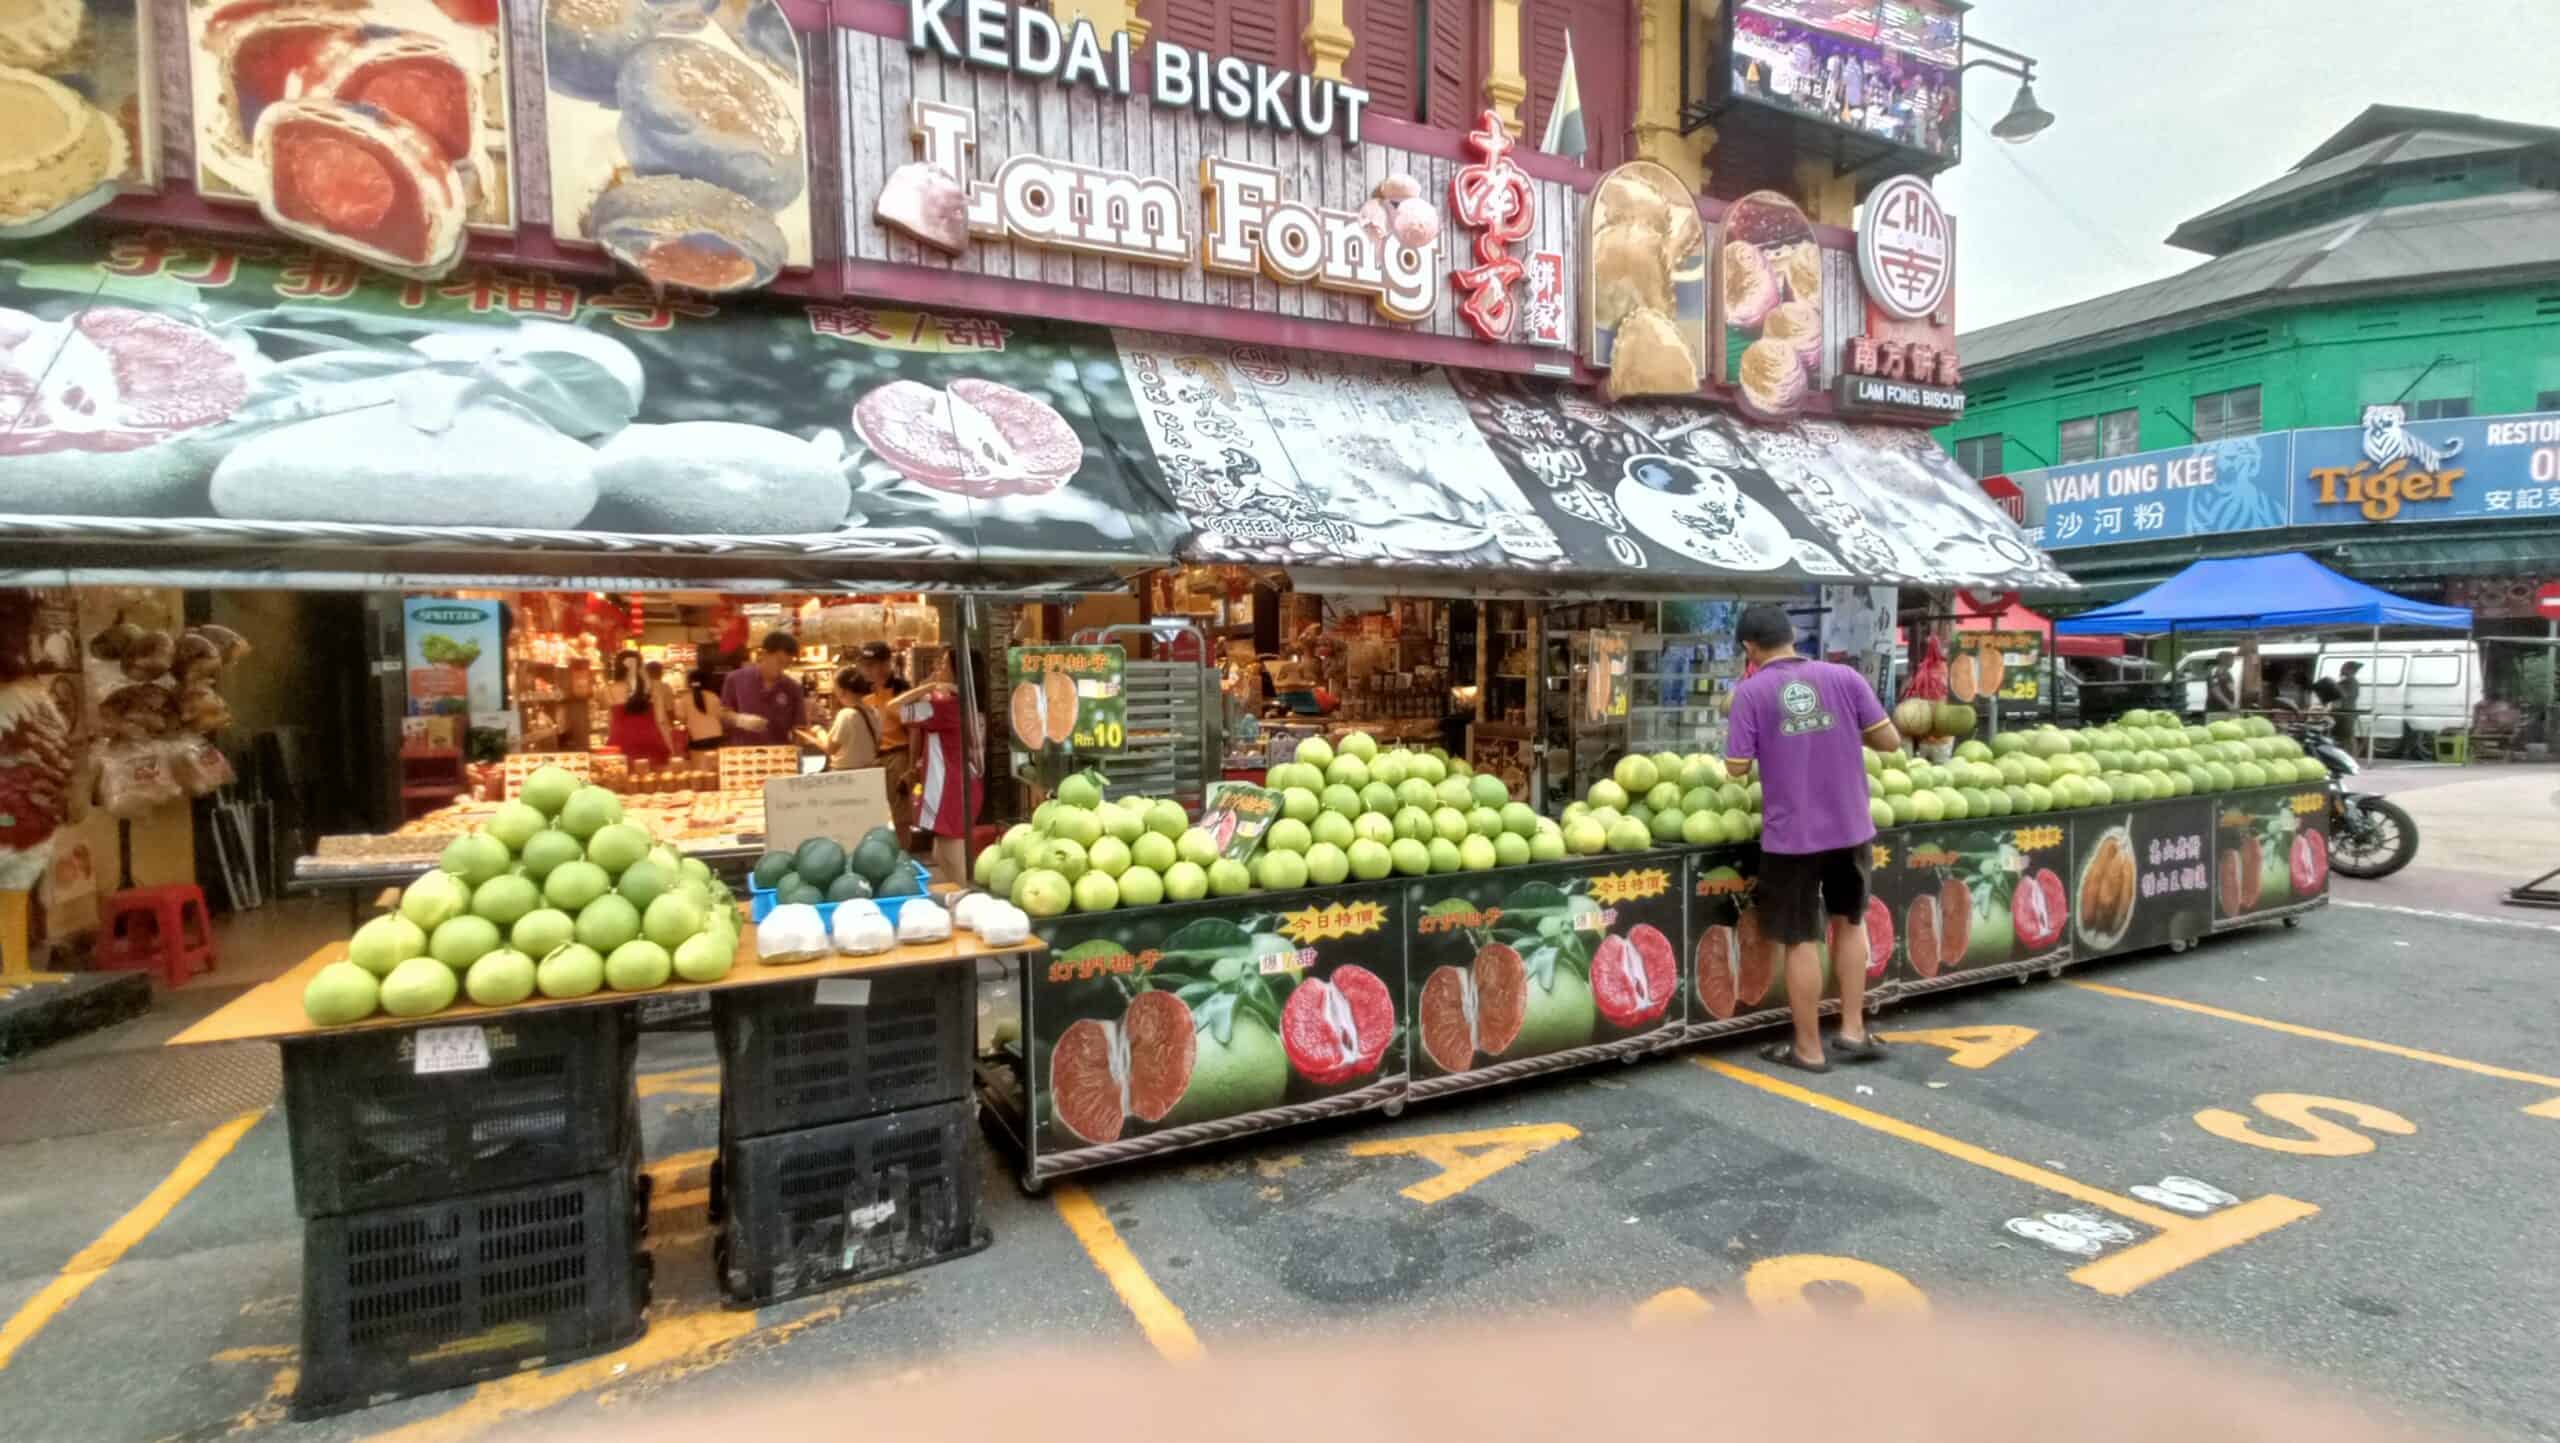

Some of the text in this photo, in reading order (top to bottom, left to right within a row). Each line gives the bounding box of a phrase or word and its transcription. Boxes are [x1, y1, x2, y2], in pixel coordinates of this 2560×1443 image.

[909, 0, 1371, 148] KEDAI BISKUT
[918, 104, 1441, 317] Lam Fong
[1453, 108, 1536, 340] 南方
[1859, 381, 1966, 411] LAM FONG BISCUIT
[2107, 462, 2158, 497] ONG
[2166, 455, 2217, 490] KEE
[2310, 458, 2466, 521] Tiger
[1207, 516, 1281, 539] COFFEE
[2055, 501, 2167, 540] 沙河粉
[1292, 909, 1374, 932] 今日特價
